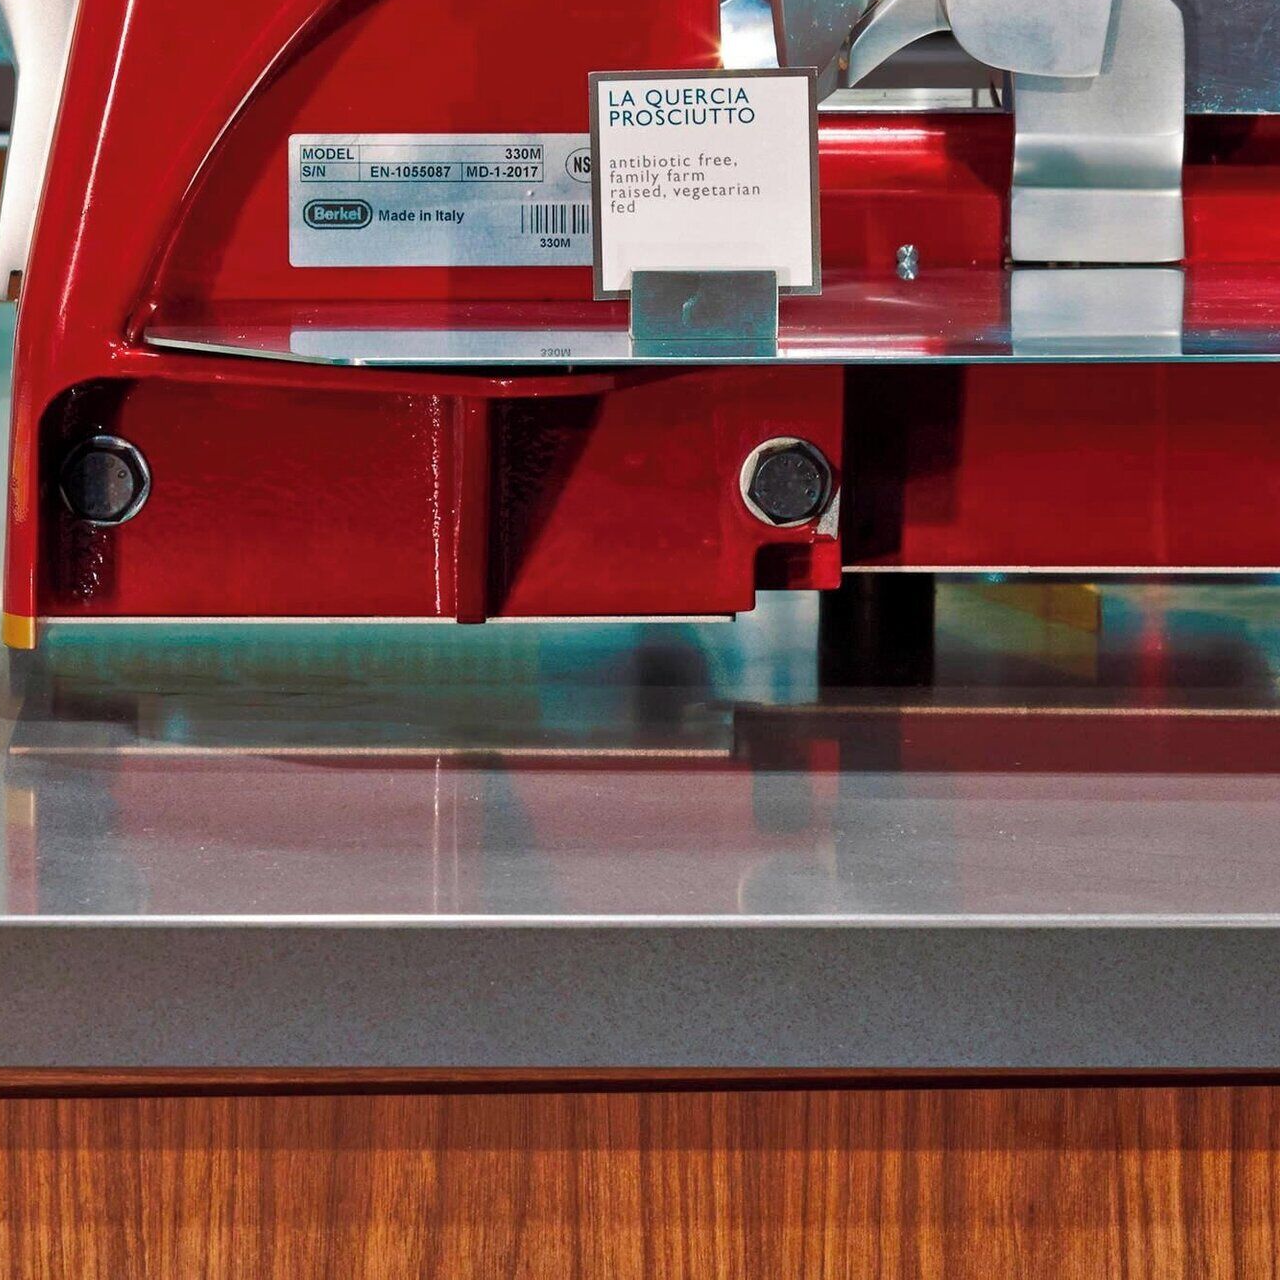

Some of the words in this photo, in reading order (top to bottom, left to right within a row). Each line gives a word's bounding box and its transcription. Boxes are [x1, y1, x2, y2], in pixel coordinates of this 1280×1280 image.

[609, 90, 635, 107] LA
[645, 87, 749, 109] QUERCIA
[609, 107, 755, 126] PROSCIUTTO
[302, 148, 355, 160] MODEL
[505, 148, 541, 160] 330M
[609, 154, 691, 169] antibiotic
[698, 153, 738, 168] free,
[302, 166, 326, 177] S/N
[370, 166, 451, 178] EN-1055087
[466, 166, 538, 178] MD-1-2017
[610, 169, 659, 187] family
[667, 169, 705, 182] farm
[610, 185, 667, 200] raised,
[673, 183, 761, 201] vegetarian
[314, 207, 361, 221] Berkel
[611, 200, 636, 214] fed
[378, 210, 416, 222] Made
[419, 210, 432, 222] in
[436, 210, 465, 224] Italy
[540, 238, 571, 248] 330M
